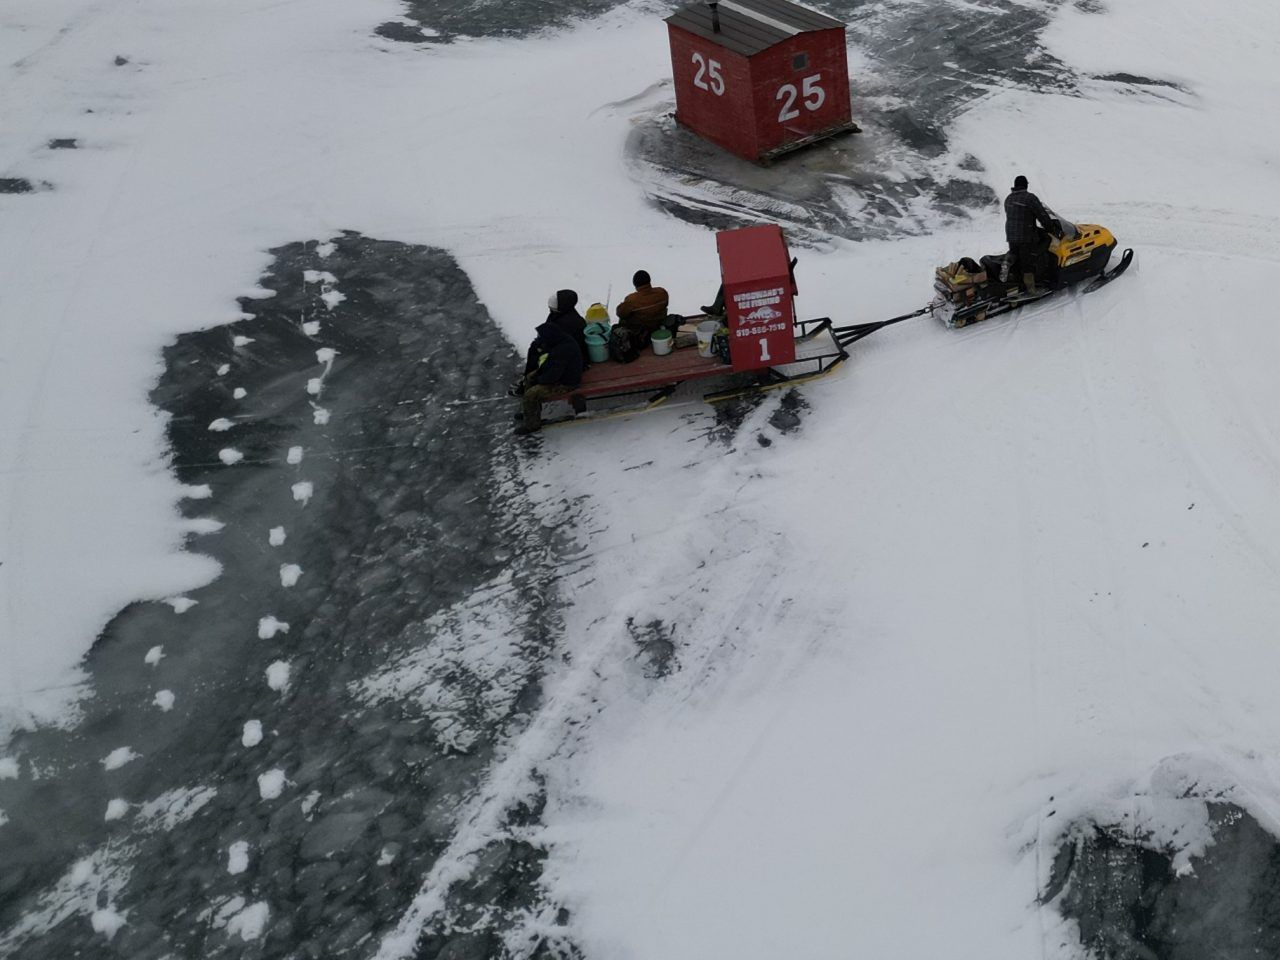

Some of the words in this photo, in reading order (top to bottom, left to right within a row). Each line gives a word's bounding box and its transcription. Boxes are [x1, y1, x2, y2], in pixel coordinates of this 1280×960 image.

[691, 52, 725, 96] 25
[776, 74, 825, 123] 25
[751, 296, 780, 307] FISHING
[759, 338, 770, 361] 1
